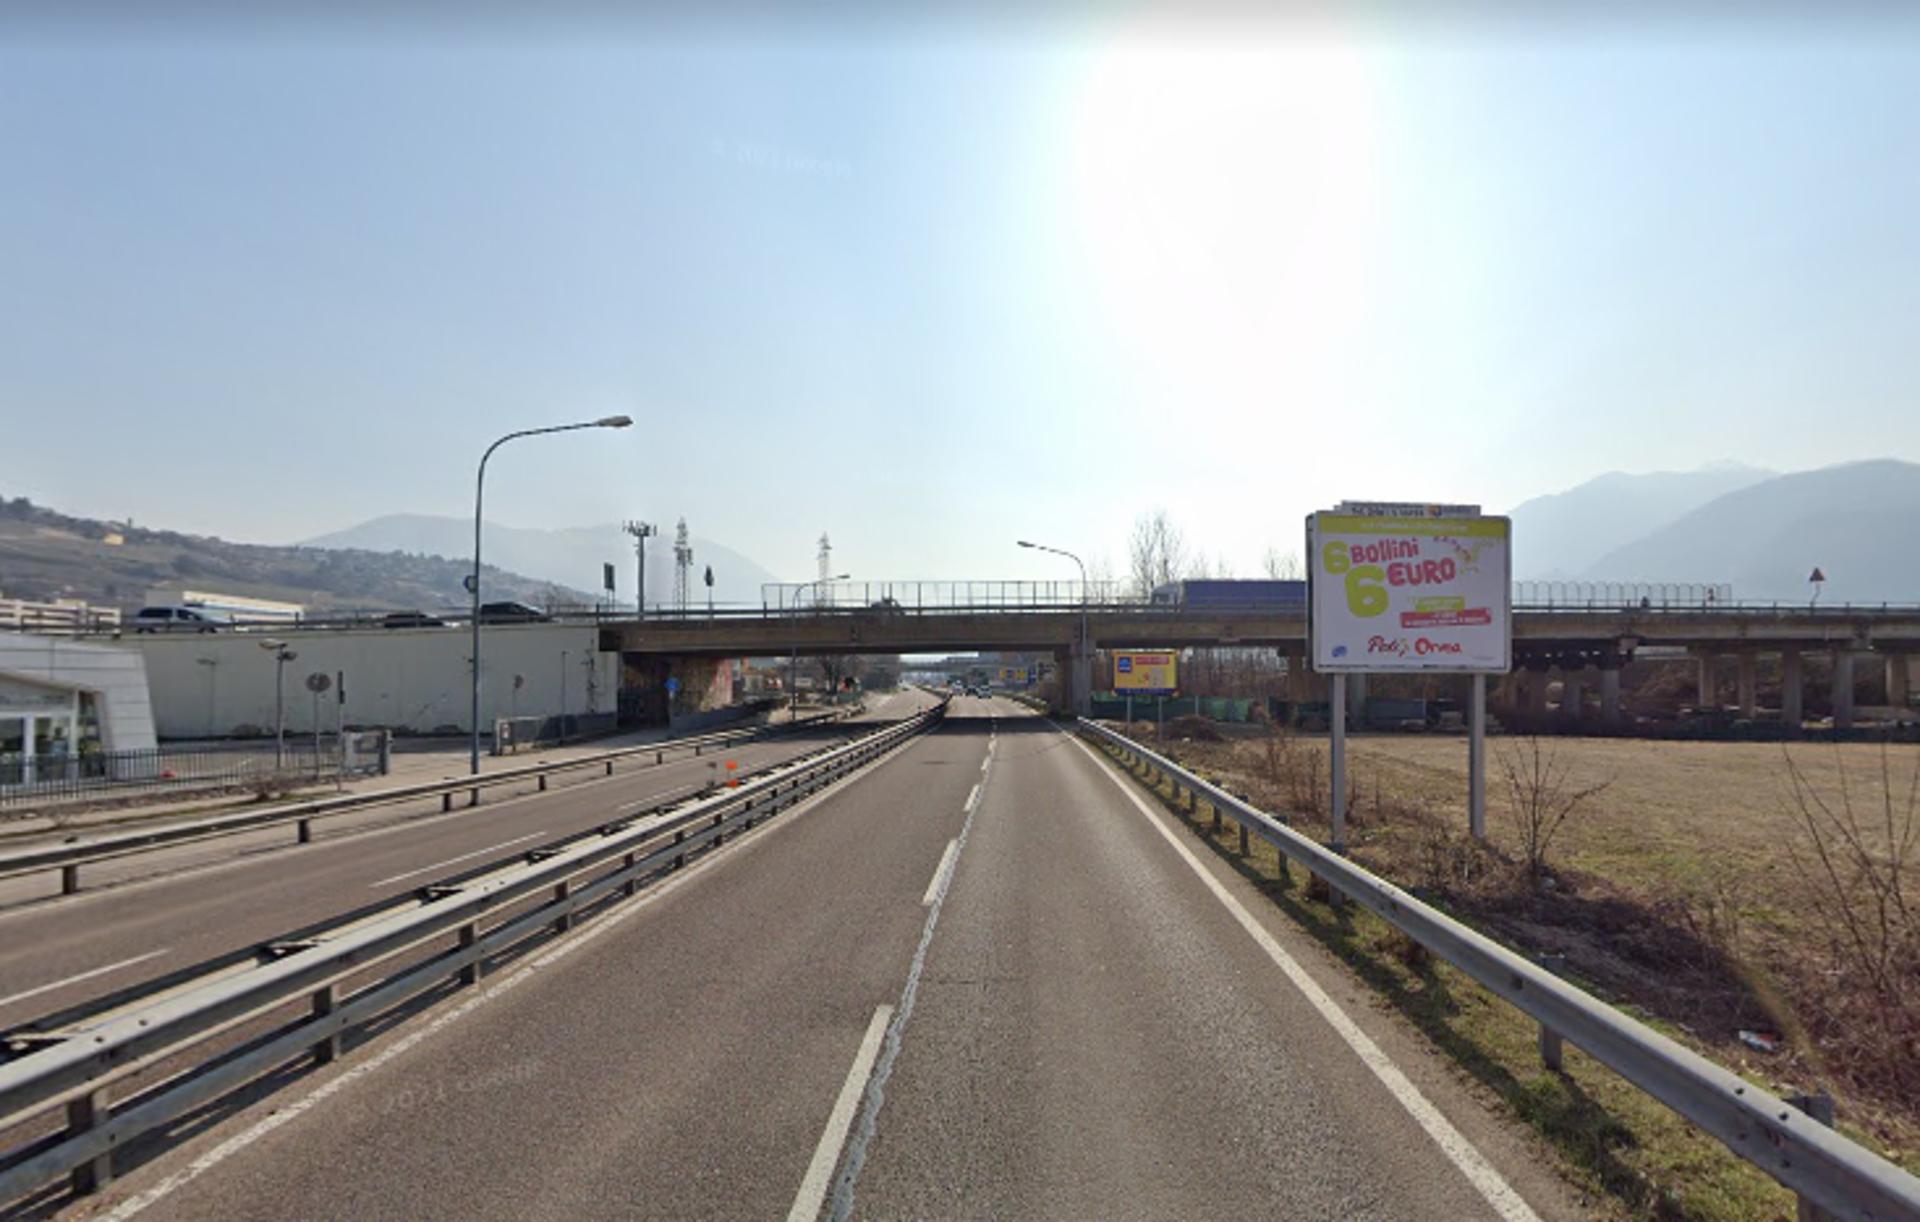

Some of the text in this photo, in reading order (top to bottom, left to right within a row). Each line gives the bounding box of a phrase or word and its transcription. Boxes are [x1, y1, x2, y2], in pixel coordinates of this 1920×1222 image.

[1323, 537, 1419, 575] 6 Bollini
[1345, 557, 1455, 618] 6 EURO
